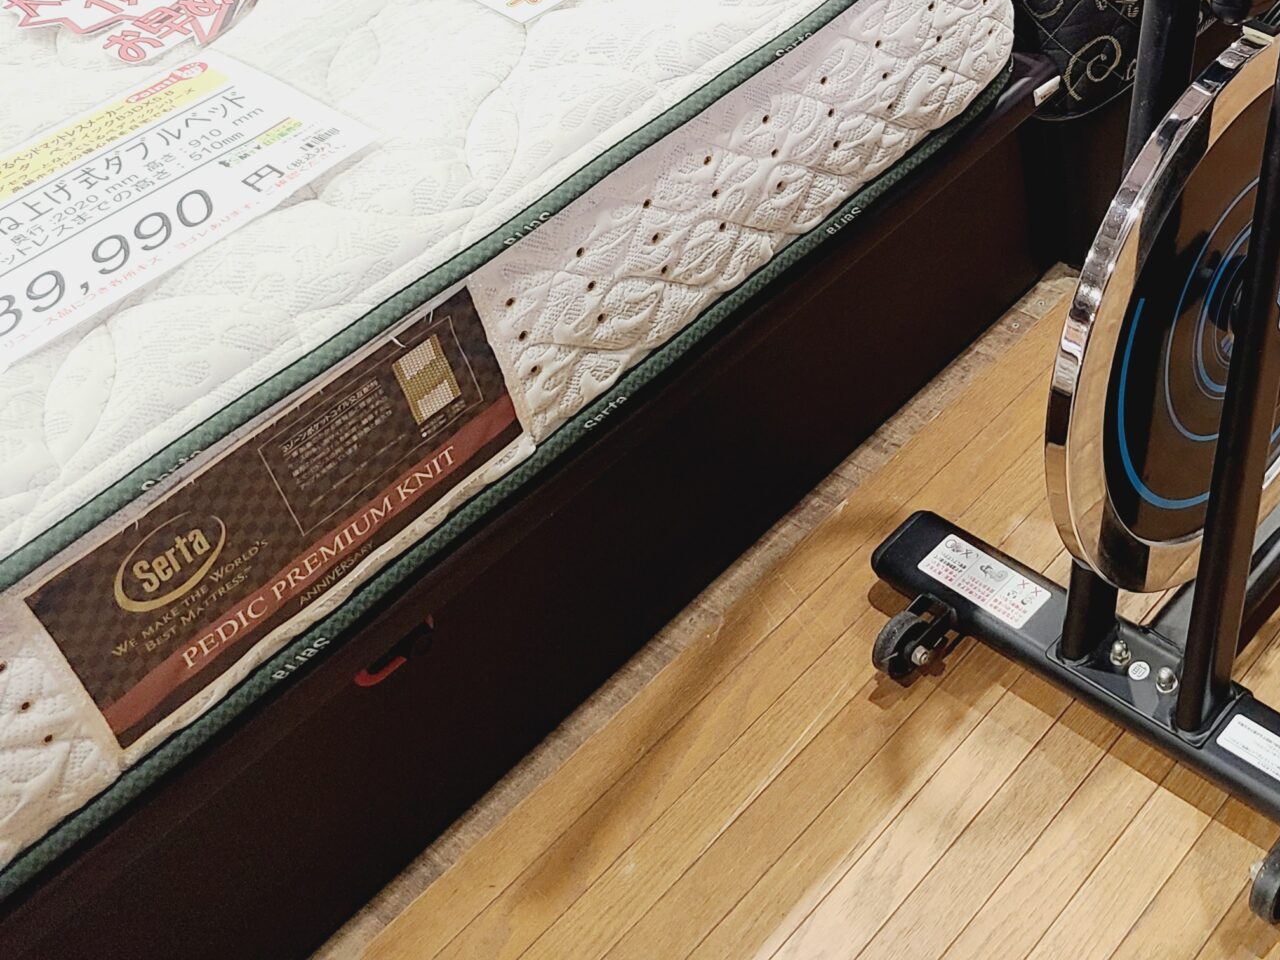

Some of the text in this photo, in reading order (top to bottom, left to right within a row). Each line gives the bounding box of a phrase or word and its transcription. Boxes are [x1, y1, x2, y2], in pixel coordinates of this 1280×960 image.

[241, 164, 285, 193] 円
[132, 528, 211, 592] Serta
[182, 596, 268, 669] PEDIC
[271, 499, 394, 601] PREMIUM
[393, 445, 455, 503] KNIT
